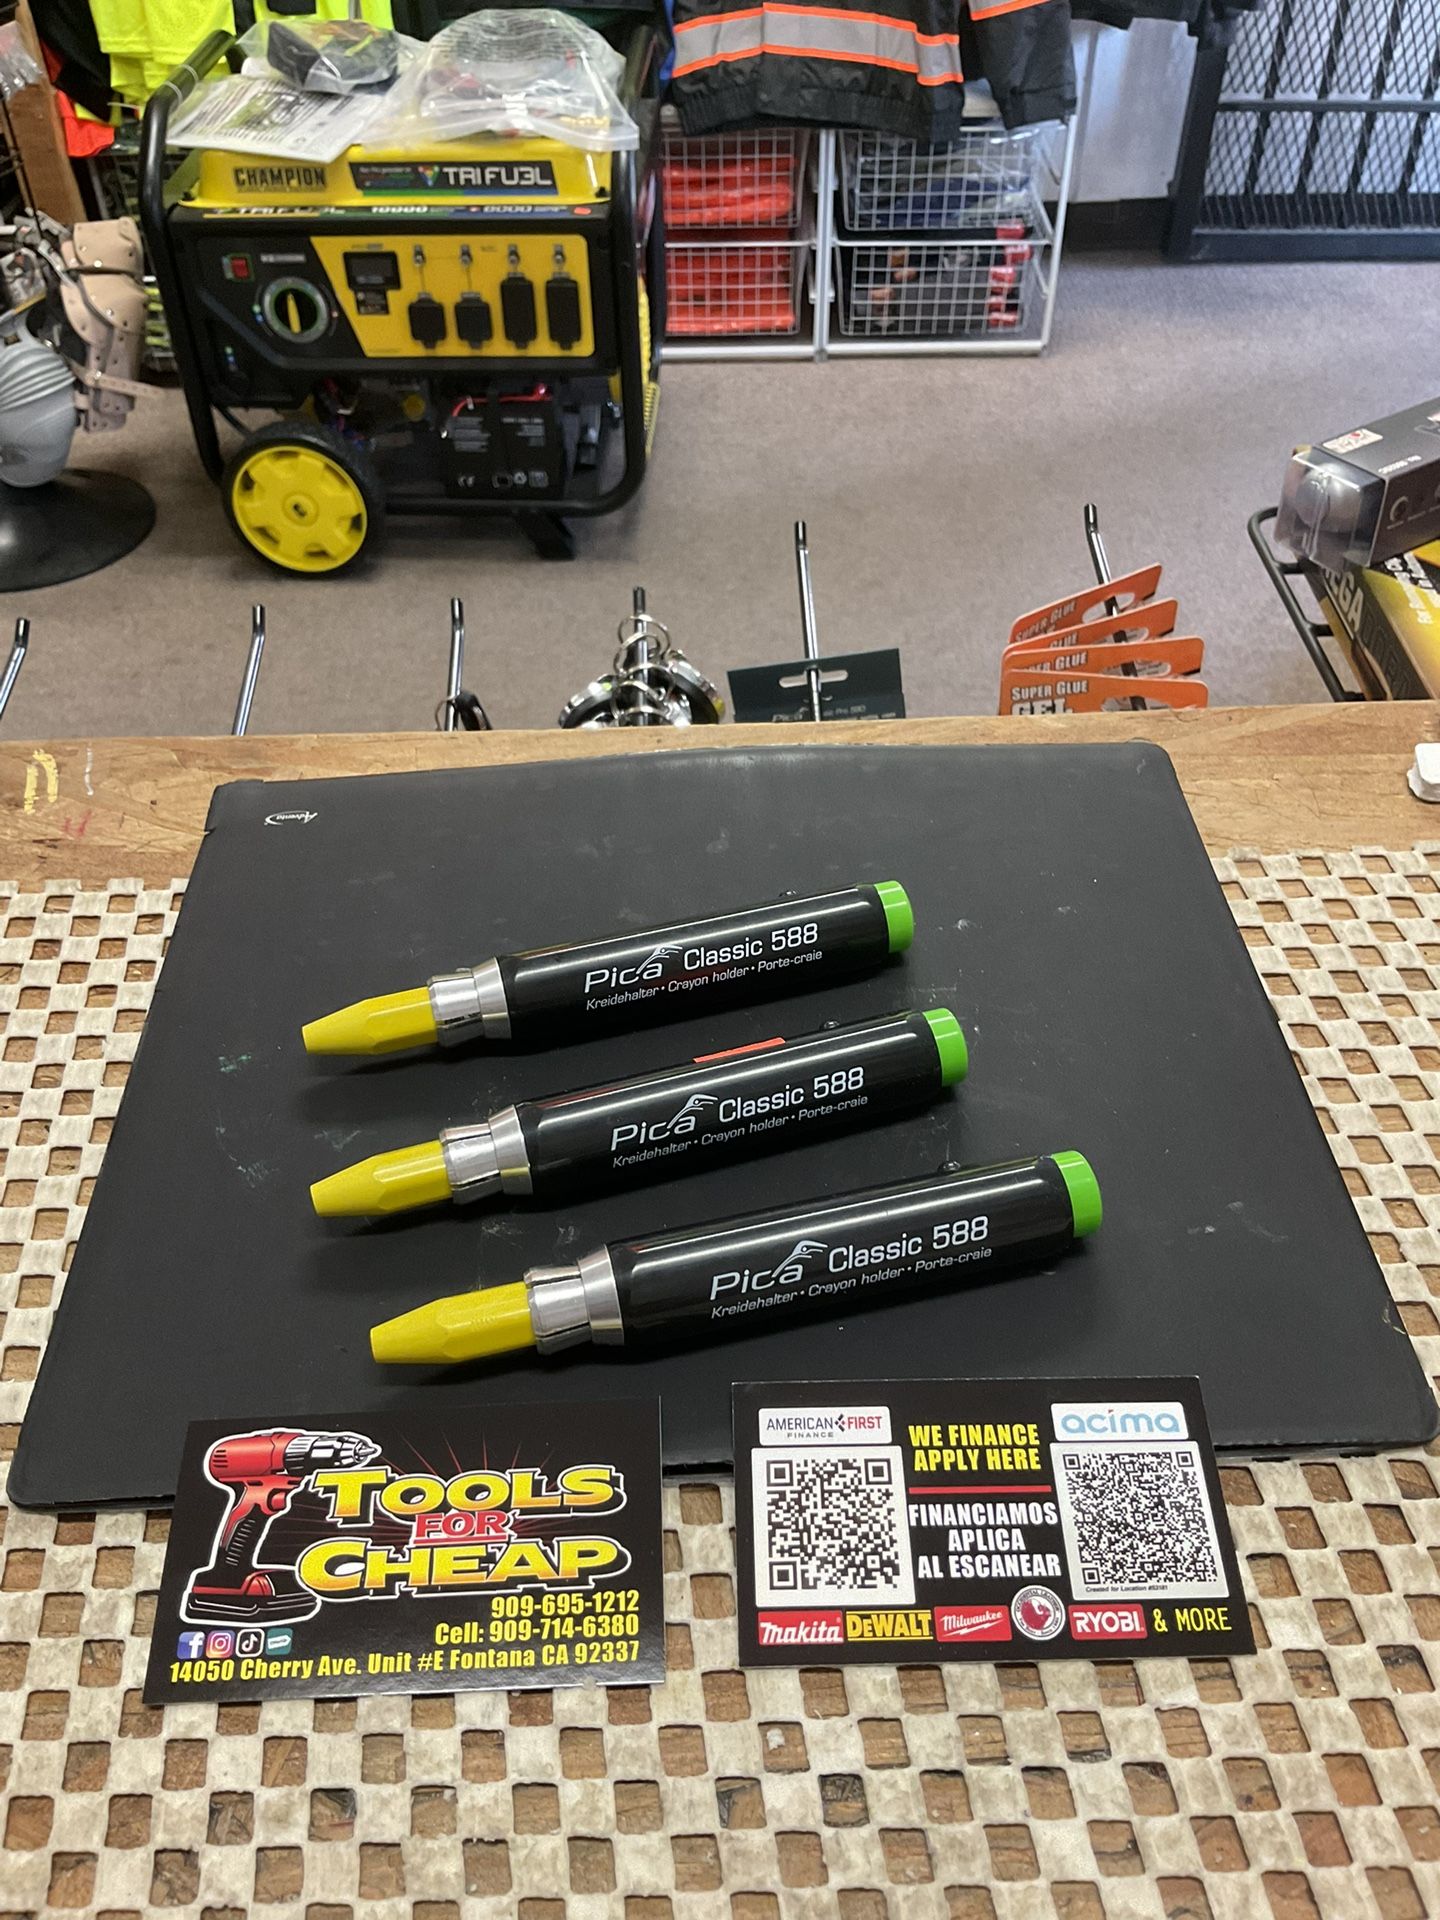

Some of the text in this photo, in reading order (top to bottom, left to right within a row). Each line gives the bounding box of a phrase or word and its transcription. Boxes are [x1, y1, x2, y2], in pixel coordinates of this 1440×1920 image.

[235, 168, 326, 187] CHAMPION
[1050, 600, 1077, 624] GLUE
[1055, 651, 1088, 672] GLUE
[1011, 680, 1088, 701] SUPER GLUE
[584, 923, 818, 993] Pica Classic 588
[586, 949, 823, 1010] Kreidehalter Crayon holder Porte-craie
[611, 1066, 864, 1150] Pica Classic 588
[613, 1094, 868, 1168] Kreidehalter Crayon holder Porte-craie
[711, 1216, 989, 1300] Pica Classic 588
[711, 1246, 992, 1319] Kreidehalter Crayon holder Porte-craie
[767, 1415, 882, 1431] AMERICAN FIRST
[1061, 1409, 1180, 1433] acima
[908, 1424, 1040, 1447] WE FINANCE
[914, 1448, 1041, 1472] APPLY HERE
[311, 1466, 619, 1519] TOOLS
[413, 1510, 508, 1540] FOR
[909, 1502, 1058, 1527] FINANCIAMOS
[948, 1529, 1026, 1551] APLICA
[299, 1539, 619, 1592] CHEAP
[918, 1553, 1062, 1578] AL ESCANEAR
[491, 1590, 640, 1618] 909-695-1212
[435, 1614, 639, 1645] Cell: 909-714-6380
[940, 1610, 1003, 1631] Milwaukee
[1073, 1611, 1140, 1632] RYOBI
[1154, 1608, 1232, 1632] & MORE
[170, 1641, 640, 1683] 14050 Cherry Ave. Unit #E Fontana CA 92337
